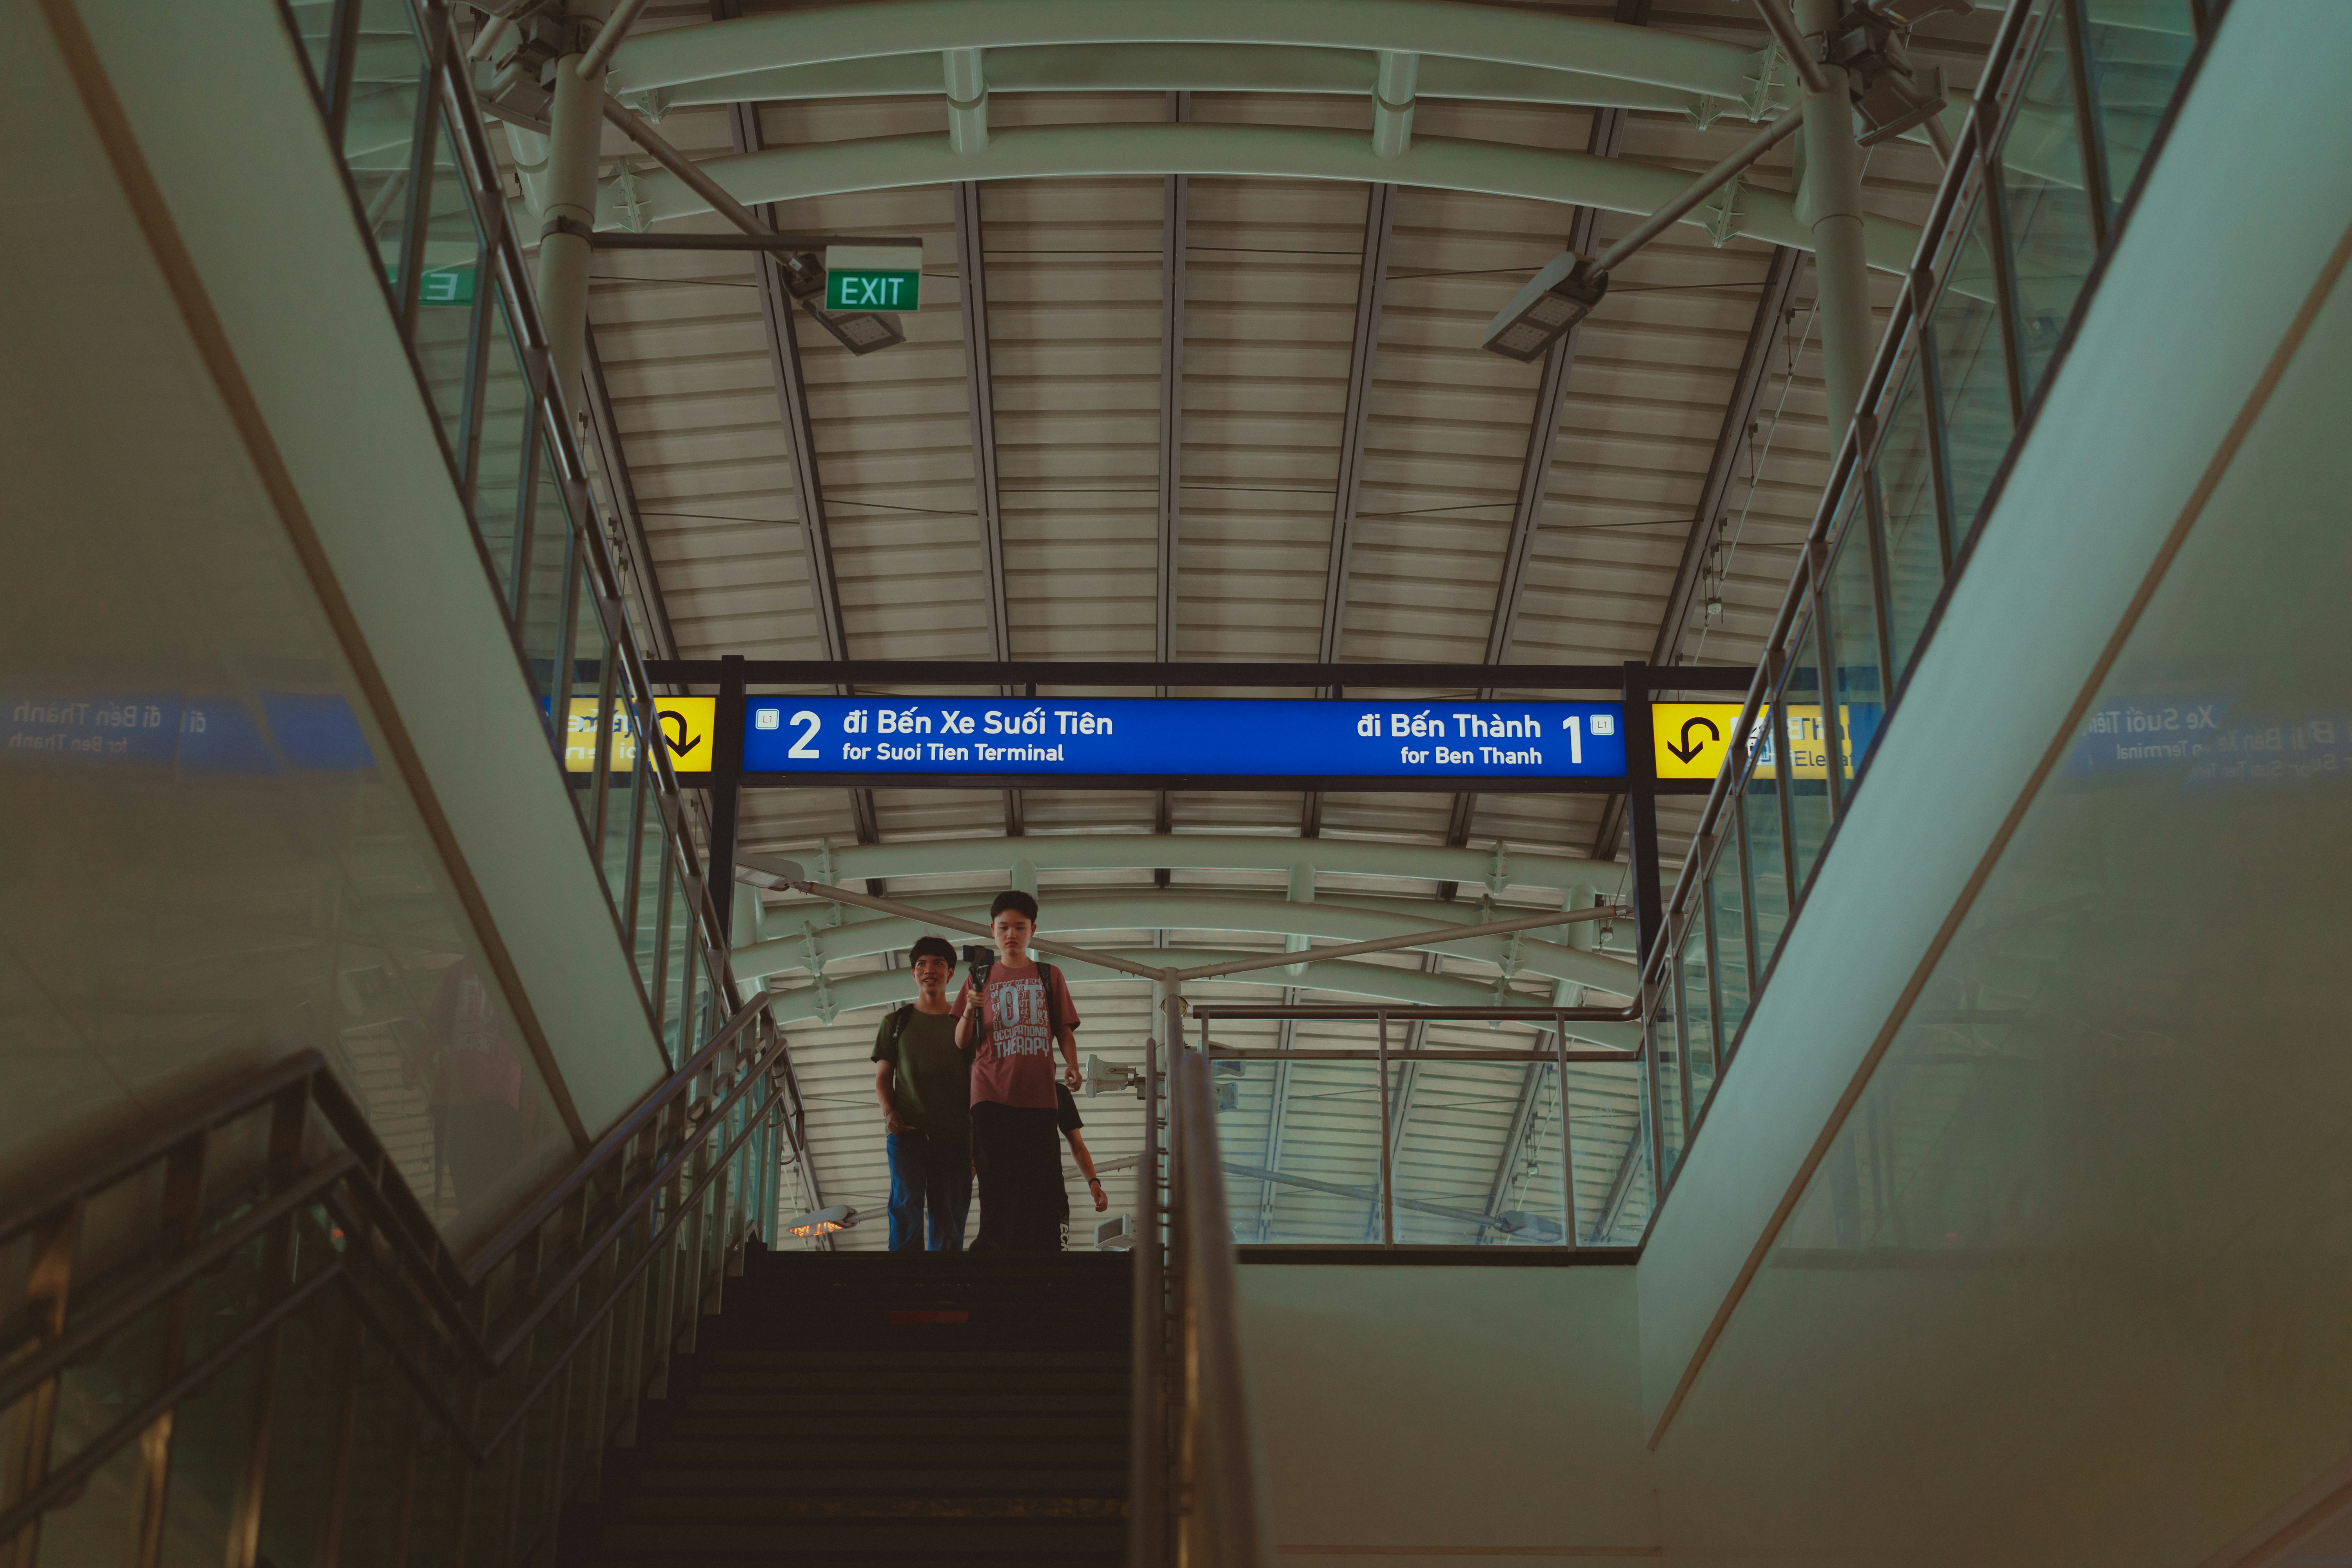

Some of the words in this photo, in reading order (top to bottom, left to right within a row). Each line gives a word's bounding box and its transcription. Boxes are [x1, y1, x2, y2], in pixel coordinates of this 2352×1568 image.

[841, 277, 904, 305] EXIT
[788, 710, 821, 759] 2
[844, 710, 867, 733] đi
[878, 706, 931, 734] Bến
[940, 710, 975, 734] Xe
[983, 707, 1046, 734] Suối
[1054, 711, 1113, 735] Tiên
[1357, 713, 1381, 737] đi
[1391, 710, 1445, 737] Bến
[1453, 713, 1541, 738] Thành
[842, 743, 872, 760] for
[877, 743, 921, 760] Suoi
[927, 743, 968, 761] Tien
[974, 743, 1064, 762] Terminal
[1563, 716, 1582, 764] 1
[1401, 746, 1430, 764] for
[1436, 746, 1474, 764] Ben
[1479, 747, 1542, 764] Thanh
[999, 984, 1042, 1027] OT
[993, 1024, 1049, 1042] OCCUPATIONAL
[994, 1036, 1049, 1058] THERAPY
